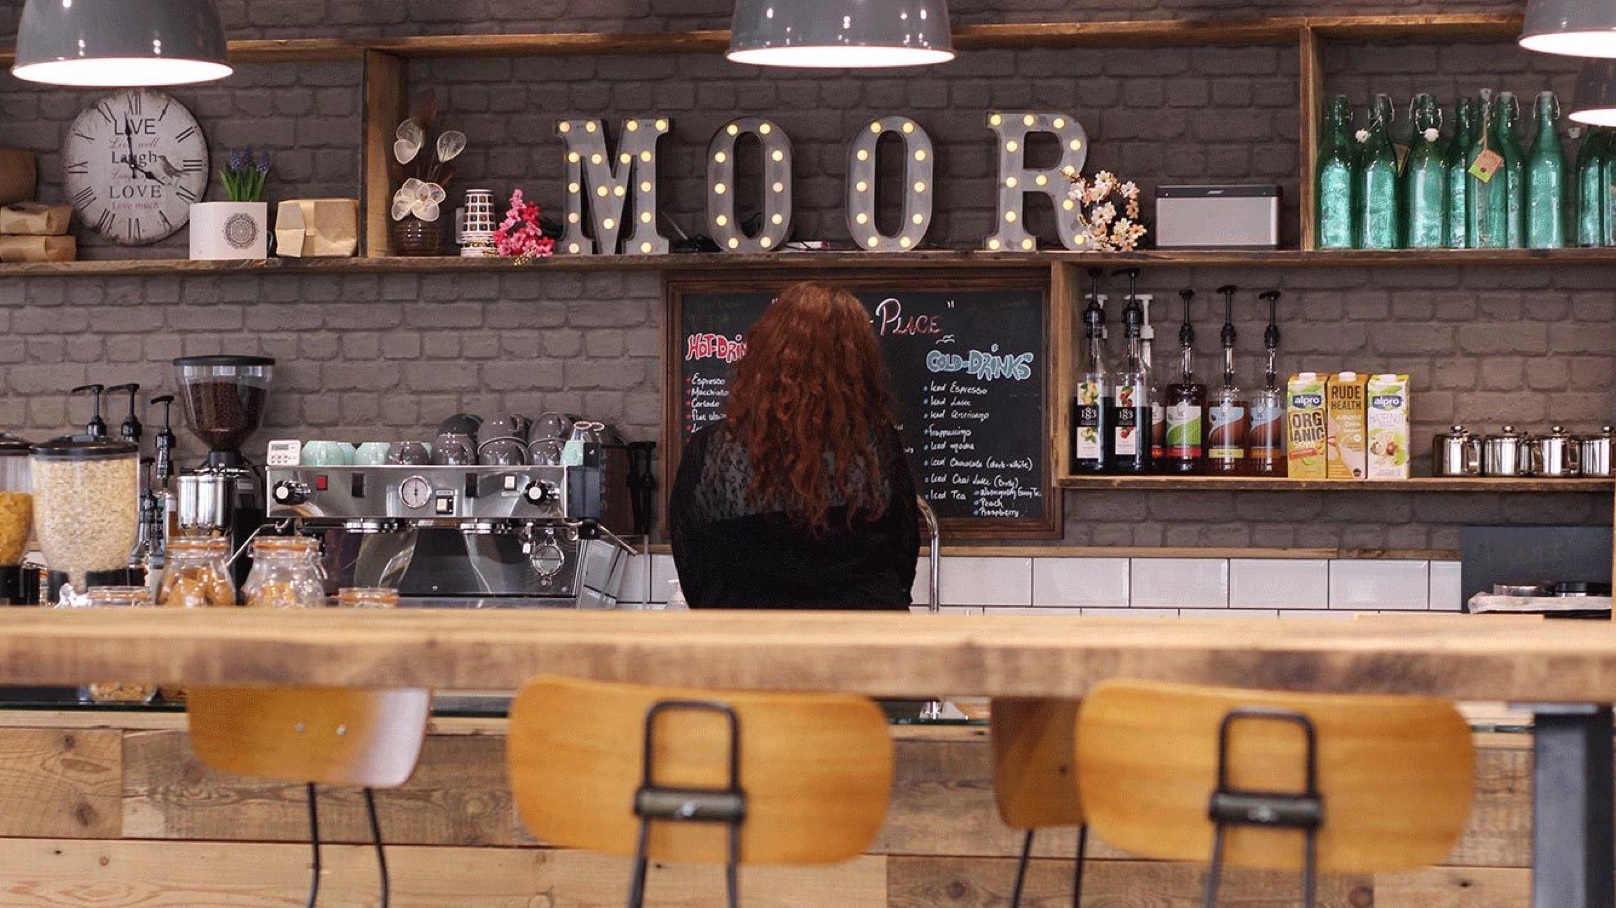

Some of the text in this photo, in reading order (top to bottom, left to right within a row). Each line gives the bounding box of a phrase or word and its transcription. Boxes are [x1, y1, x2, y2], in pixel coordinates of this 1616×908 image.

[114, 118, 156, 135] LVE
[556, 110, 1092, 254] MOOR
[109, 185, 162, 199] LOVE
[1331, 385, 1361, 399] RUDE
[1294, 395, 1320, 406] alpro
[1331, 401, 1362, 410] HEALTH
[1373, 396, 1400, 407] alpro
[1293, 412, 1322, 428] ORG
[1294, 427, 1325, 443] ANIC
[930, 489, 947, 500] Iced
[950, 490, 967, 500] Tea
